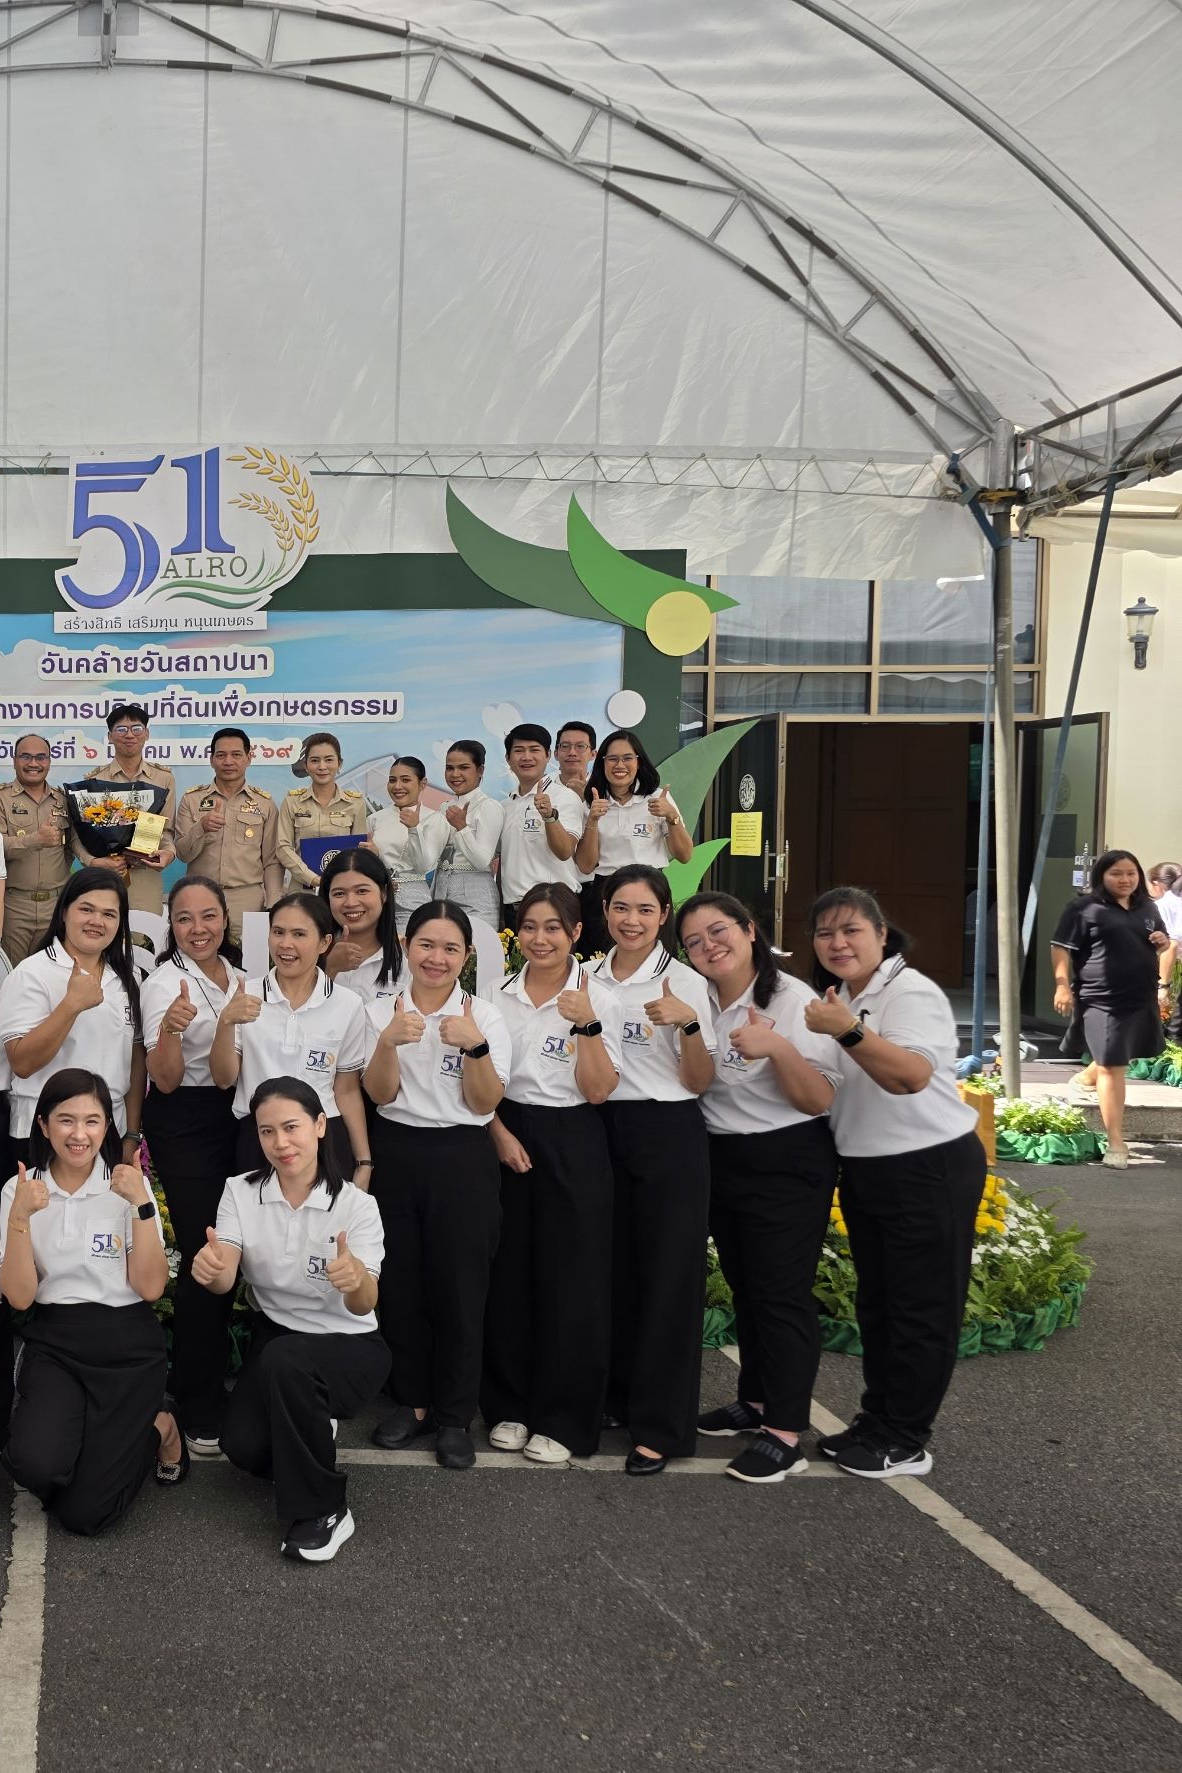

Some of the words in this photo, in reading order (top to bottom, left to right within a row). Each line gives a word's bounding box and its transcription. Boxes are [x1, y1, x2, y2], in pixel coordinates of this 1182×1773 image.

[61, 446, 235, 609] 51
[160, 555, 248, 579] ALRO
[63, 616, 122, 630] สร้างสิทธิ
[128, 615, 178, 632] เสริมทุน
[184, 615, 254, 631] หนุนเกษตร
[41, 651, 269, 674] วันคล้ายวันสถาปนา
[622, 1022, 642, 1039] 51
[542, 1036, 565, 1053] 51
[306, 1049, 327, 1067] 51
[441, 1054, 463, 1072] 51
[91, 1234, 113, 1253] 51
[307, 1256, 327, 1275] 51
